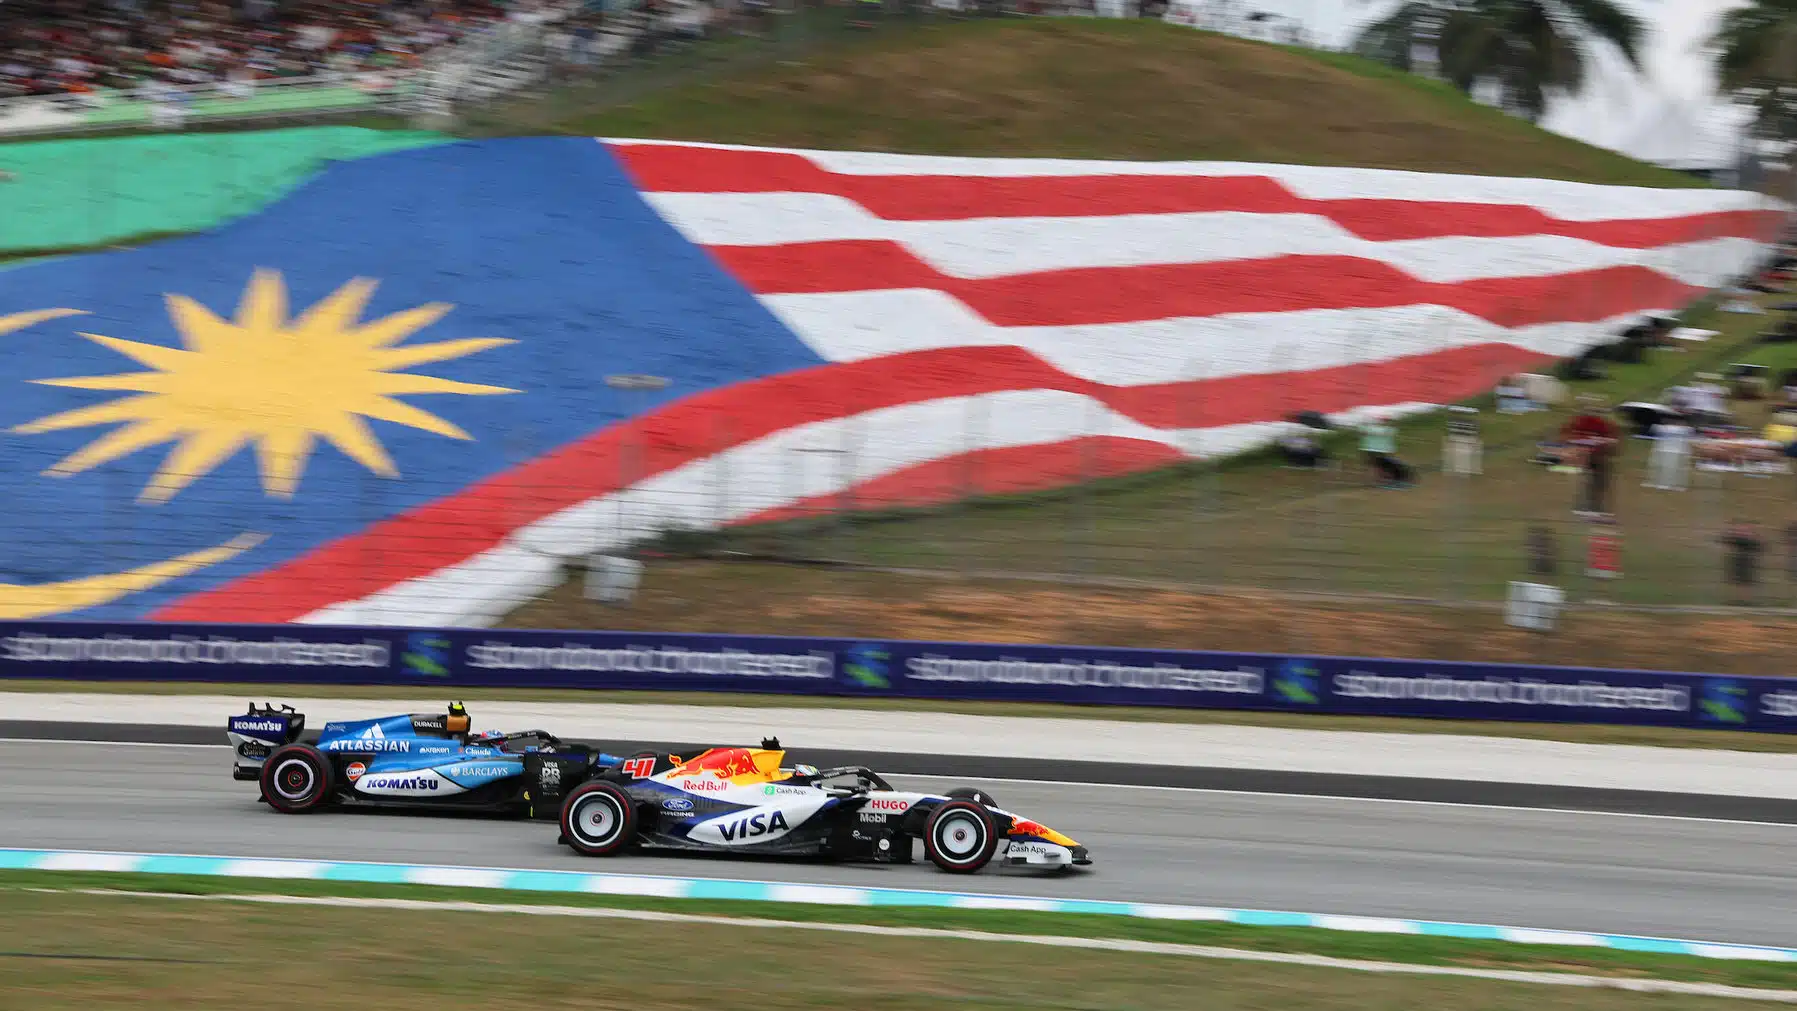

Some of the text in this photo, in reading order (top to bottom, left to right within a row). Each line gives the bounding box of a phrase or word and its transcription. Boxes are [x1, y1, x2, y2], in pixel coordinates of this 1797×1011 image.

[234, 720, 282, 732] KOMATSU
[414, 720, 442, 729] DURACELL
[330, 739, 410, 753] ATLASSIAN
[465, 746, 491, 757] Claude
[462, 767, 508, 777] BARCLAYS
[623, 757, 656, 779] 41
[367, 776, 439, 790] KOMATSU
[683, 780, 728, 791] Red Bull
[776, 786, 807, 796] Cash App
[871, 799, 909, 811] HUGO
[860, 813, 887, 824] Mobil
[717, 810, 790, 842] VISA
[1010, 845, 1047, 855] Cash App
